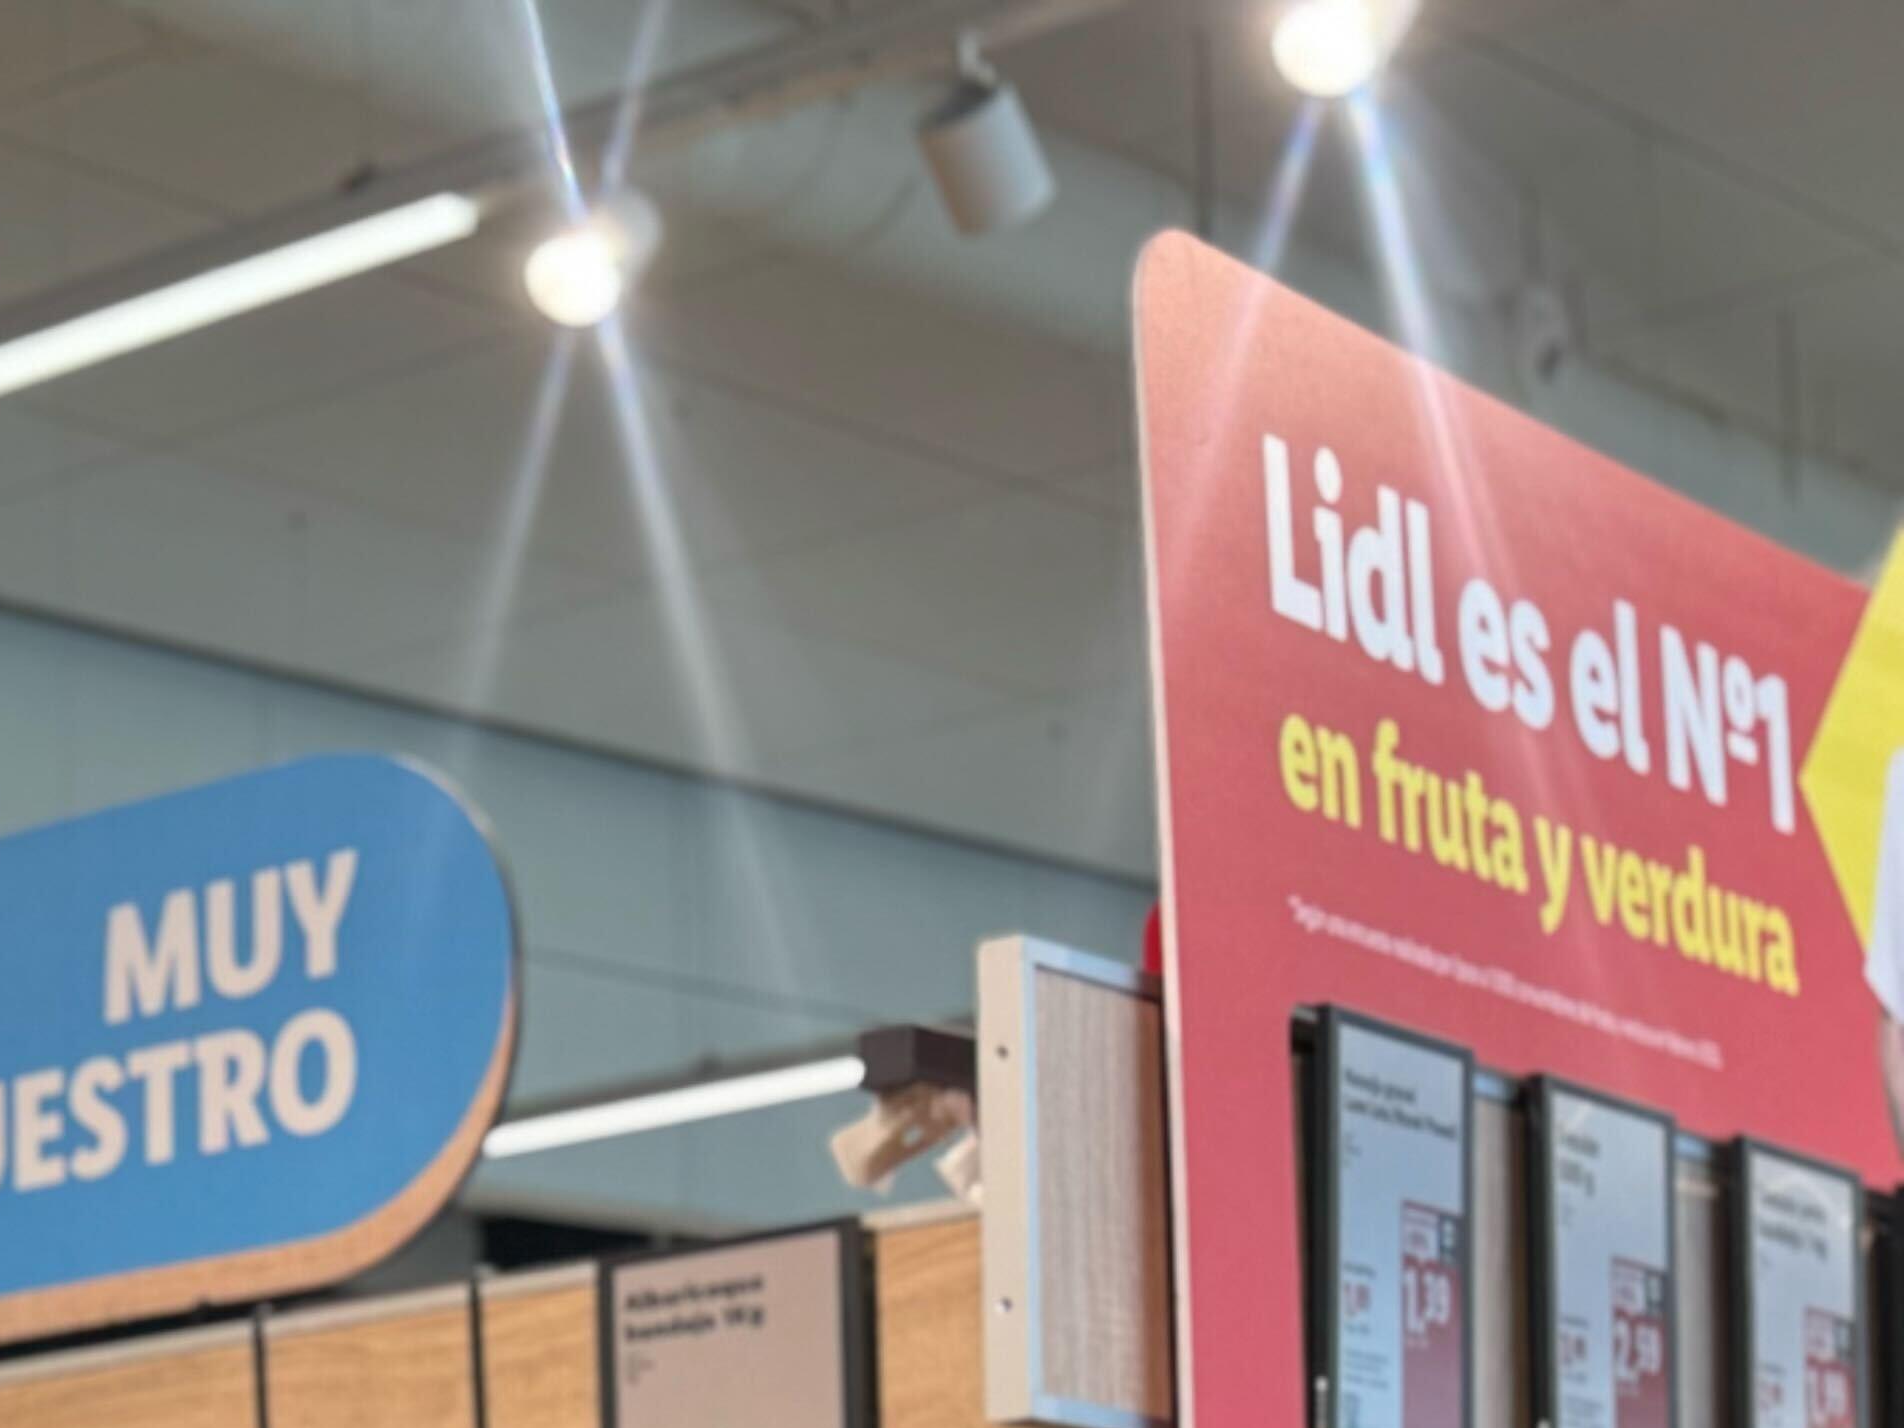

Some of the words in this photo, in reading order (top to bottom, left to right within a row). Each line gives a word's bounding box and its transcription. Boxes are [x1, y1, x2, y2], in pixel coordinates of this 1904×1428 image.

[1262, 432, 1444, 686] Lidl
[1457, 577, 1556, 731] es
[1570, 599, 1651, 776] el
[103, 848, 358, 1026] MUY
[1279, 712, 1362, 829] en
[1372, 718, 1530, 895] fruta
[1533, 815, 1574, 934] y
[1580, 833, 1800, 997] verdura
